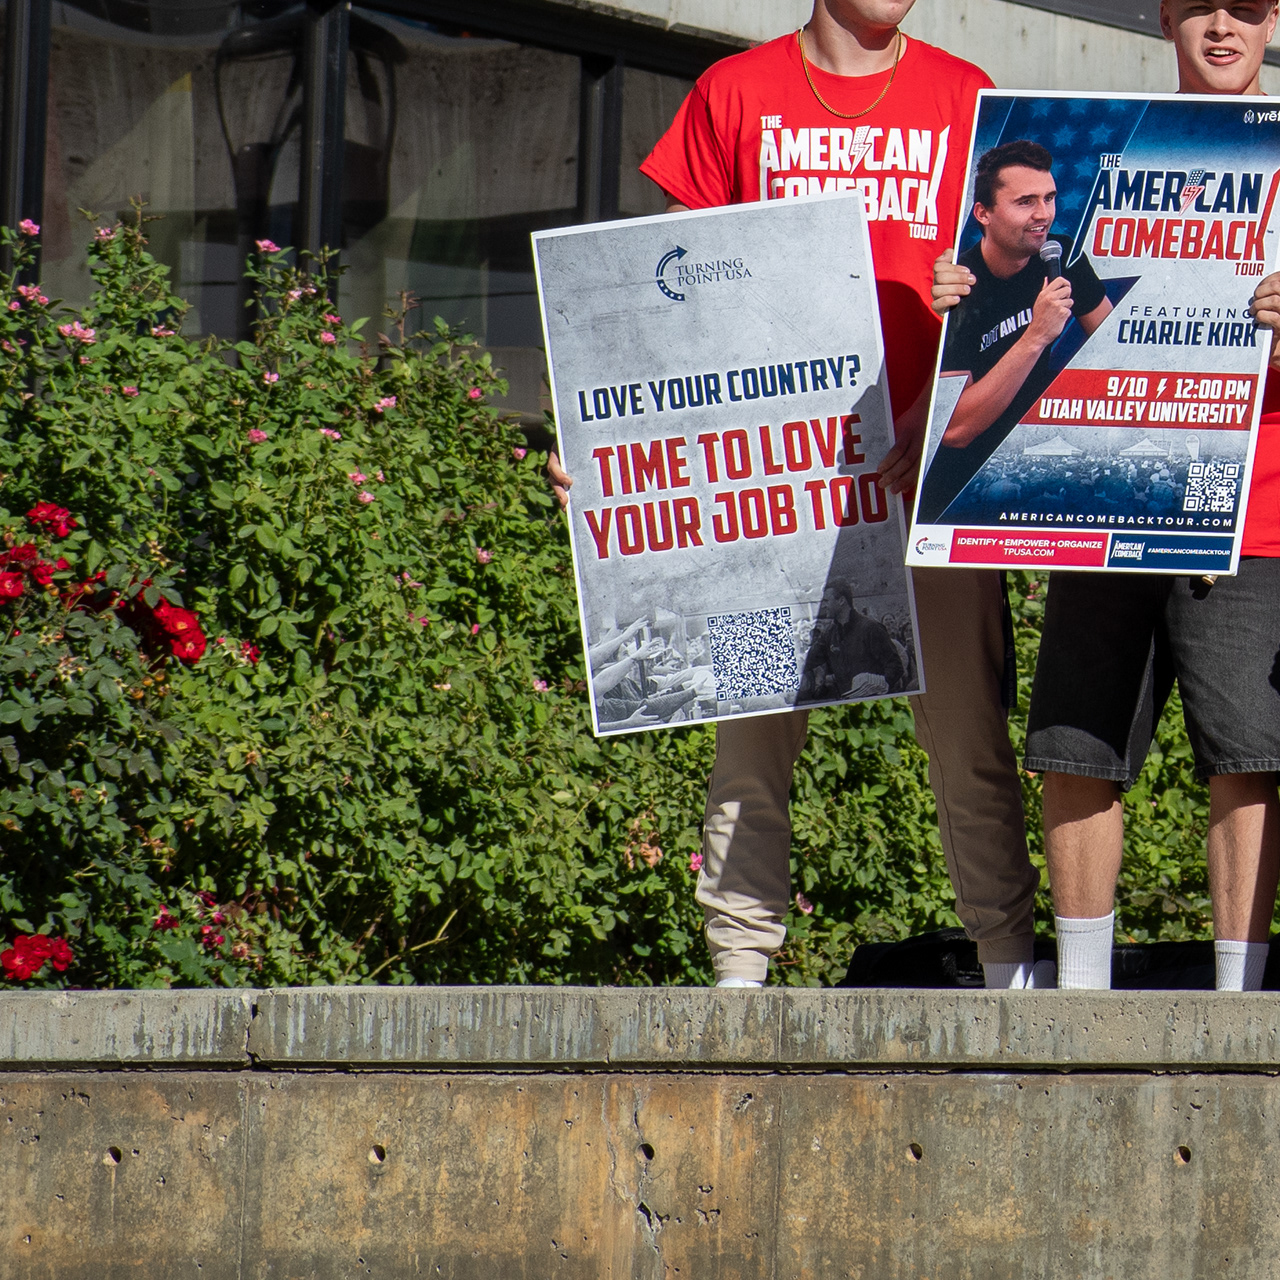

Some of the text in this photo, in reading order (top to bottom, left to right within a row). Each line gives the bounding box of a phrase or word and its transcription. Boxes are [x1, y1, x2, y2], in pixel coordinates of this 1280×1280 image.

[760, 115, 782, 130] THE
[759, 125, 932, 174] AMERICAN
[1100, 154, 1121, 168] THE
[1092, 168, 1263, 215] AMERICAN
[908, 223, 938, 240] TOUR
[1092, 218, 1265, 264] COMEBACK
[675, 258, 743, 278] TURNING
[677, 267, 752, 287] POINT USA
[1235, 263, 1264, 276] TOUR
[1130, 305, 1255, 318] FEATURING
[1000, 316, 1017, 337] AN
[1118, 318, 1257, 347] CHARLIE KIRK
[578, 355, 861, 422] LOVE YOUR COUNTRY?
[1107, 377, 1250, 400] 9/10 12:00 PM
[1040, 398, 1247, 424] UTAH VALLEY UNIVERSITY
[592, 414, 865, 498] TIME TO LOVE
[583, 472, 889, 559] YOUR JOB TOO
[1000, 511, 1232, 527] AMERICANCOMEBACKTOUR.COM
[958, 538, 1102, 548] IDENTIFY EMPOWER ORGANIZE
[1004, 548, 1054, 556] TPUSA.COM
